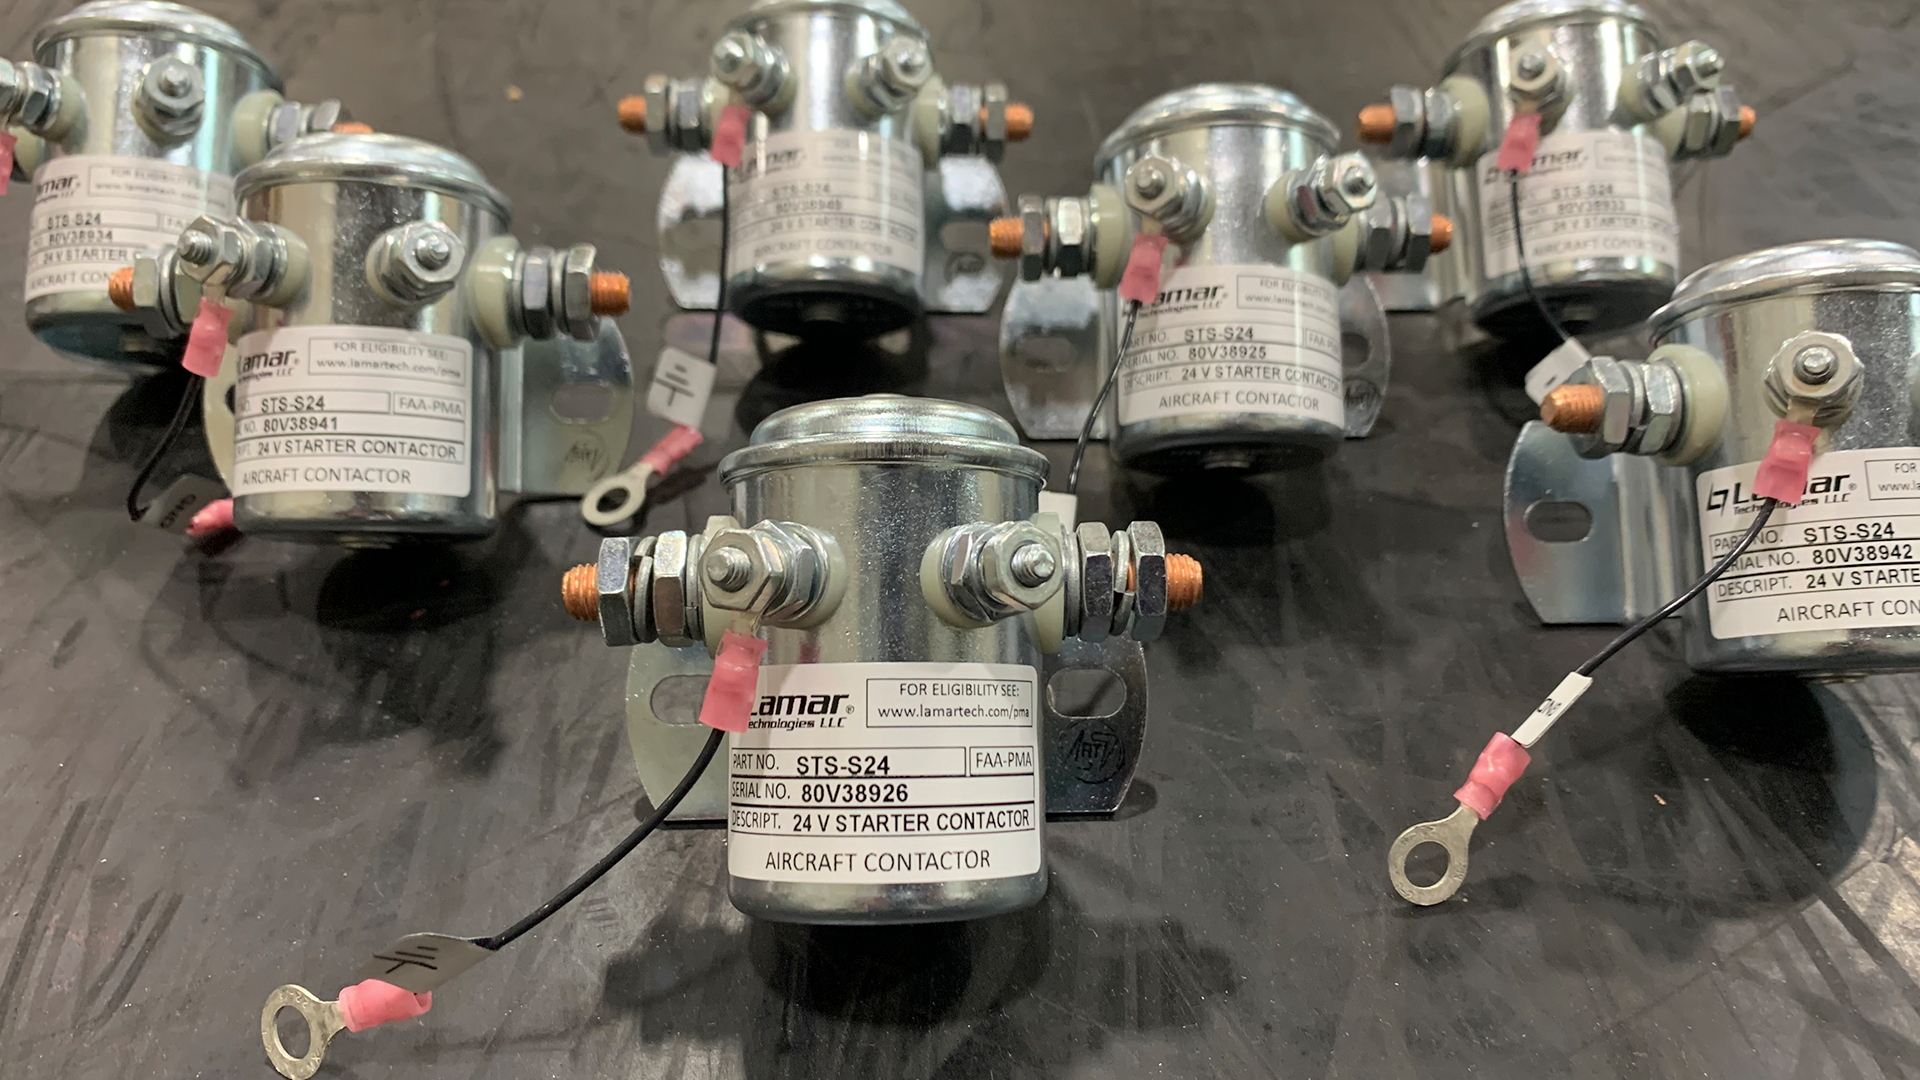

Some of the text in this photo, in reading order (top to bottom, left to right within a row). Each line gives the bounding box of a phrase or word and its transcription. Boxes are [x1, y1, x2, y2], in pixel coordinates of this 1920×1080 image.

[1602, 236, 1667, 253] CONTATOR
[66, 247, 128, 262] STARTER
[1260, 279, 1279, 289] FOR
[1149, 331, 1170, 345] NO.
[1184, 327, 1254, 342] STS-S24
[334, 342, 357, 352] FOR
[361, 343, 424, 357] ELIGIBILITY
[1158, 349, 1179, 362] NO.
[1189, 346, 1266, 361] 80V38925
[317, 358, 461, 378] www.lamartech.com/pma
[1182, 367, 1196, 381] 24
[1202, 366, 1211, 379] V
[1215, 366, 1280, 381] STARTER
[1285, 368, 1339, 392] CONTACTOR
[261, 396, 325, 413] STS-S24
[400, 397, 462, 415] FAA-PMA
[1159, 391, 1319, 411] AIRCRAFT CONTACTOR
[263, 417, 337, 433] 80V38941
[258, 441, 269, 456] 24
[273, 441, 281, 453] V
[285, 439, 356, 454] STARTER
[363, 441, 456, 459] CONTACTOR
[242, 467, 411, 486] AIRCRAFT CONTACTOR
[1894, 463, 1917, 473] FOR
[1825, 493, 1850, 503] LLC
[1714, 523, 1895, 551] PAR NO. STS-S24
[1723, 544, 1913, 573] RIAL NO. 80V38942
[1718, 576, 1792, 597] DESCRIPT.
[1806, 574, 1826, 589] 24
[1832, 572, 1844, 586] V
[1777, 601, 1875, 623] AIRCRAFT
[900, 683, 1020, 697] FOR ELIGIBILITY SEE:
[878, 705, 1029, 720] www.lamartech.com/pma
[748, 717, 847, 731] echnologies LLC
[733, 754, 890, 775] PART NO. STS-S24
[976, 752, 1032, 768] FAA-PMA
[732, 783, 908, 803] SERIAL NO. 80V38926
[732, 810, 1030, 832] DESCRIPT. 24 V STARTER CONTACTOR
[765, 850, 990, 872] AIRCRAFT CONTACTOR
